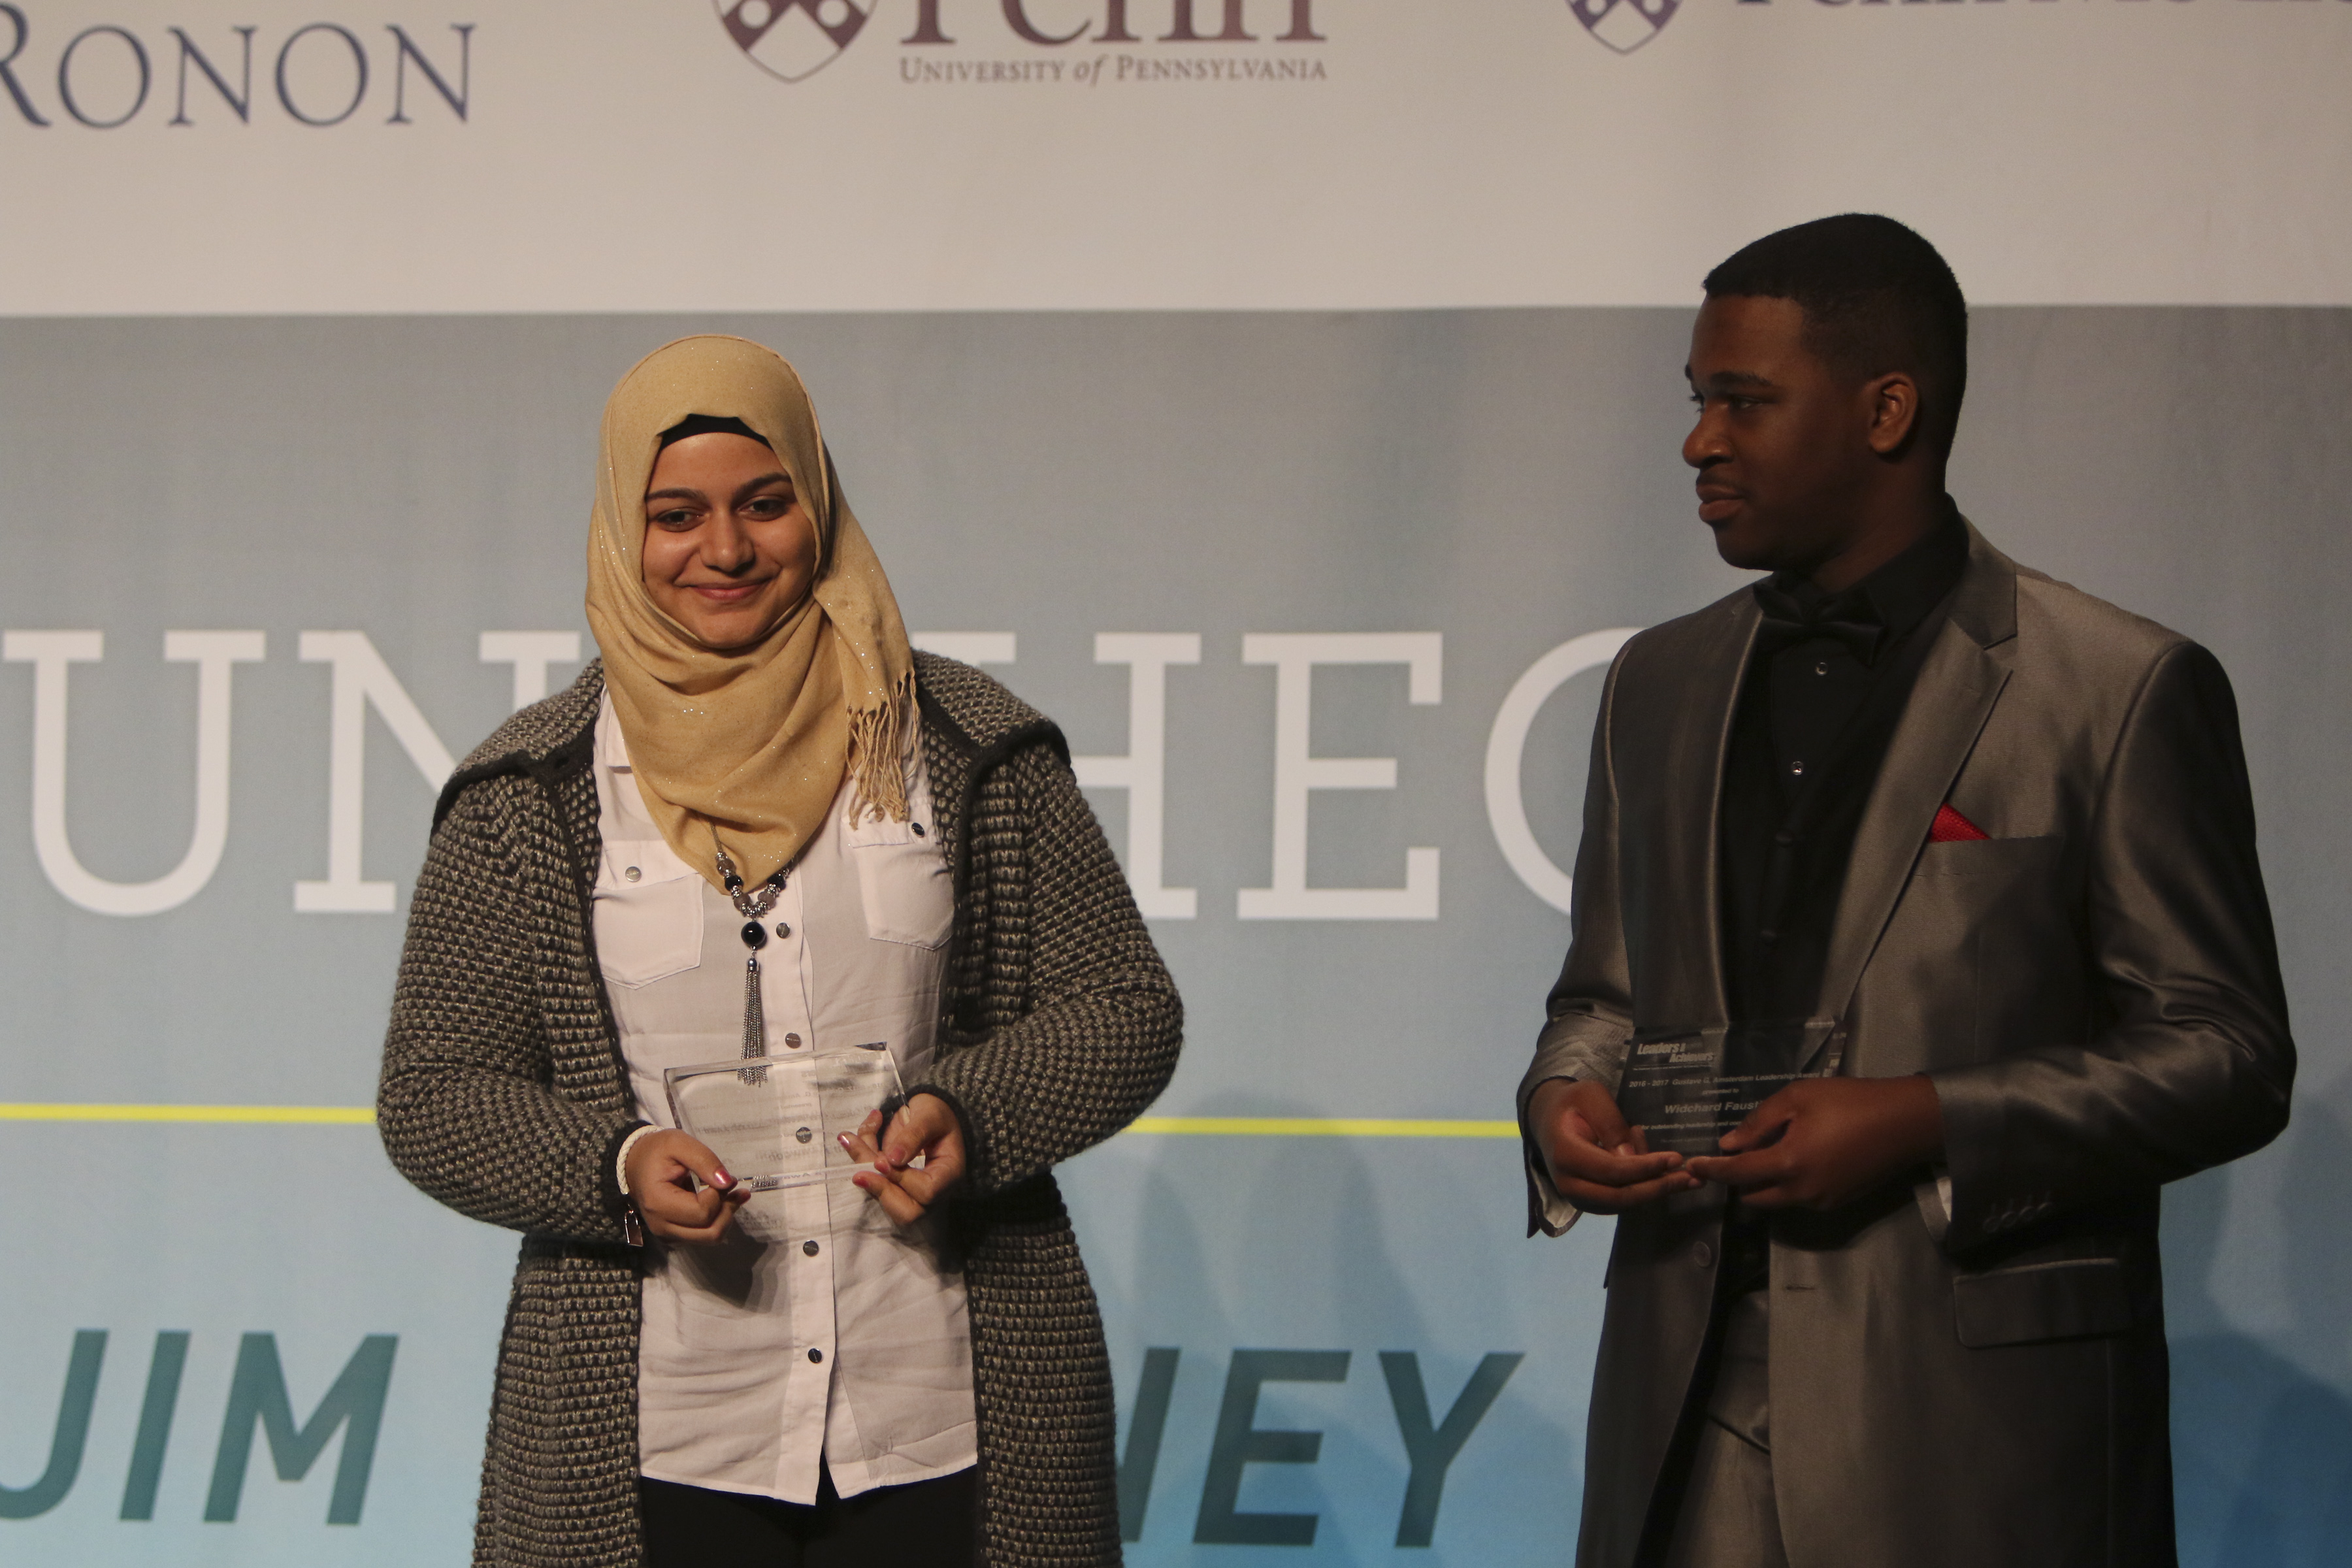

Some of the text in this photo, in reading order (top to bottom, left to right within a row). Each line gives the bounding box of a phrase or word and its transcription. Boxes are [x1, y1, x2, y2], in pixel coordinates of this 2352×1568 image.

[900, 54, 1326, 86] UNIVERSITY of PENNSYLVANIA
[1637, 1042, 1679, 1054] Leaders
[1665, 1102, 1722, 1114] Widchard
[0, 1328, 400, 1526] JIM
